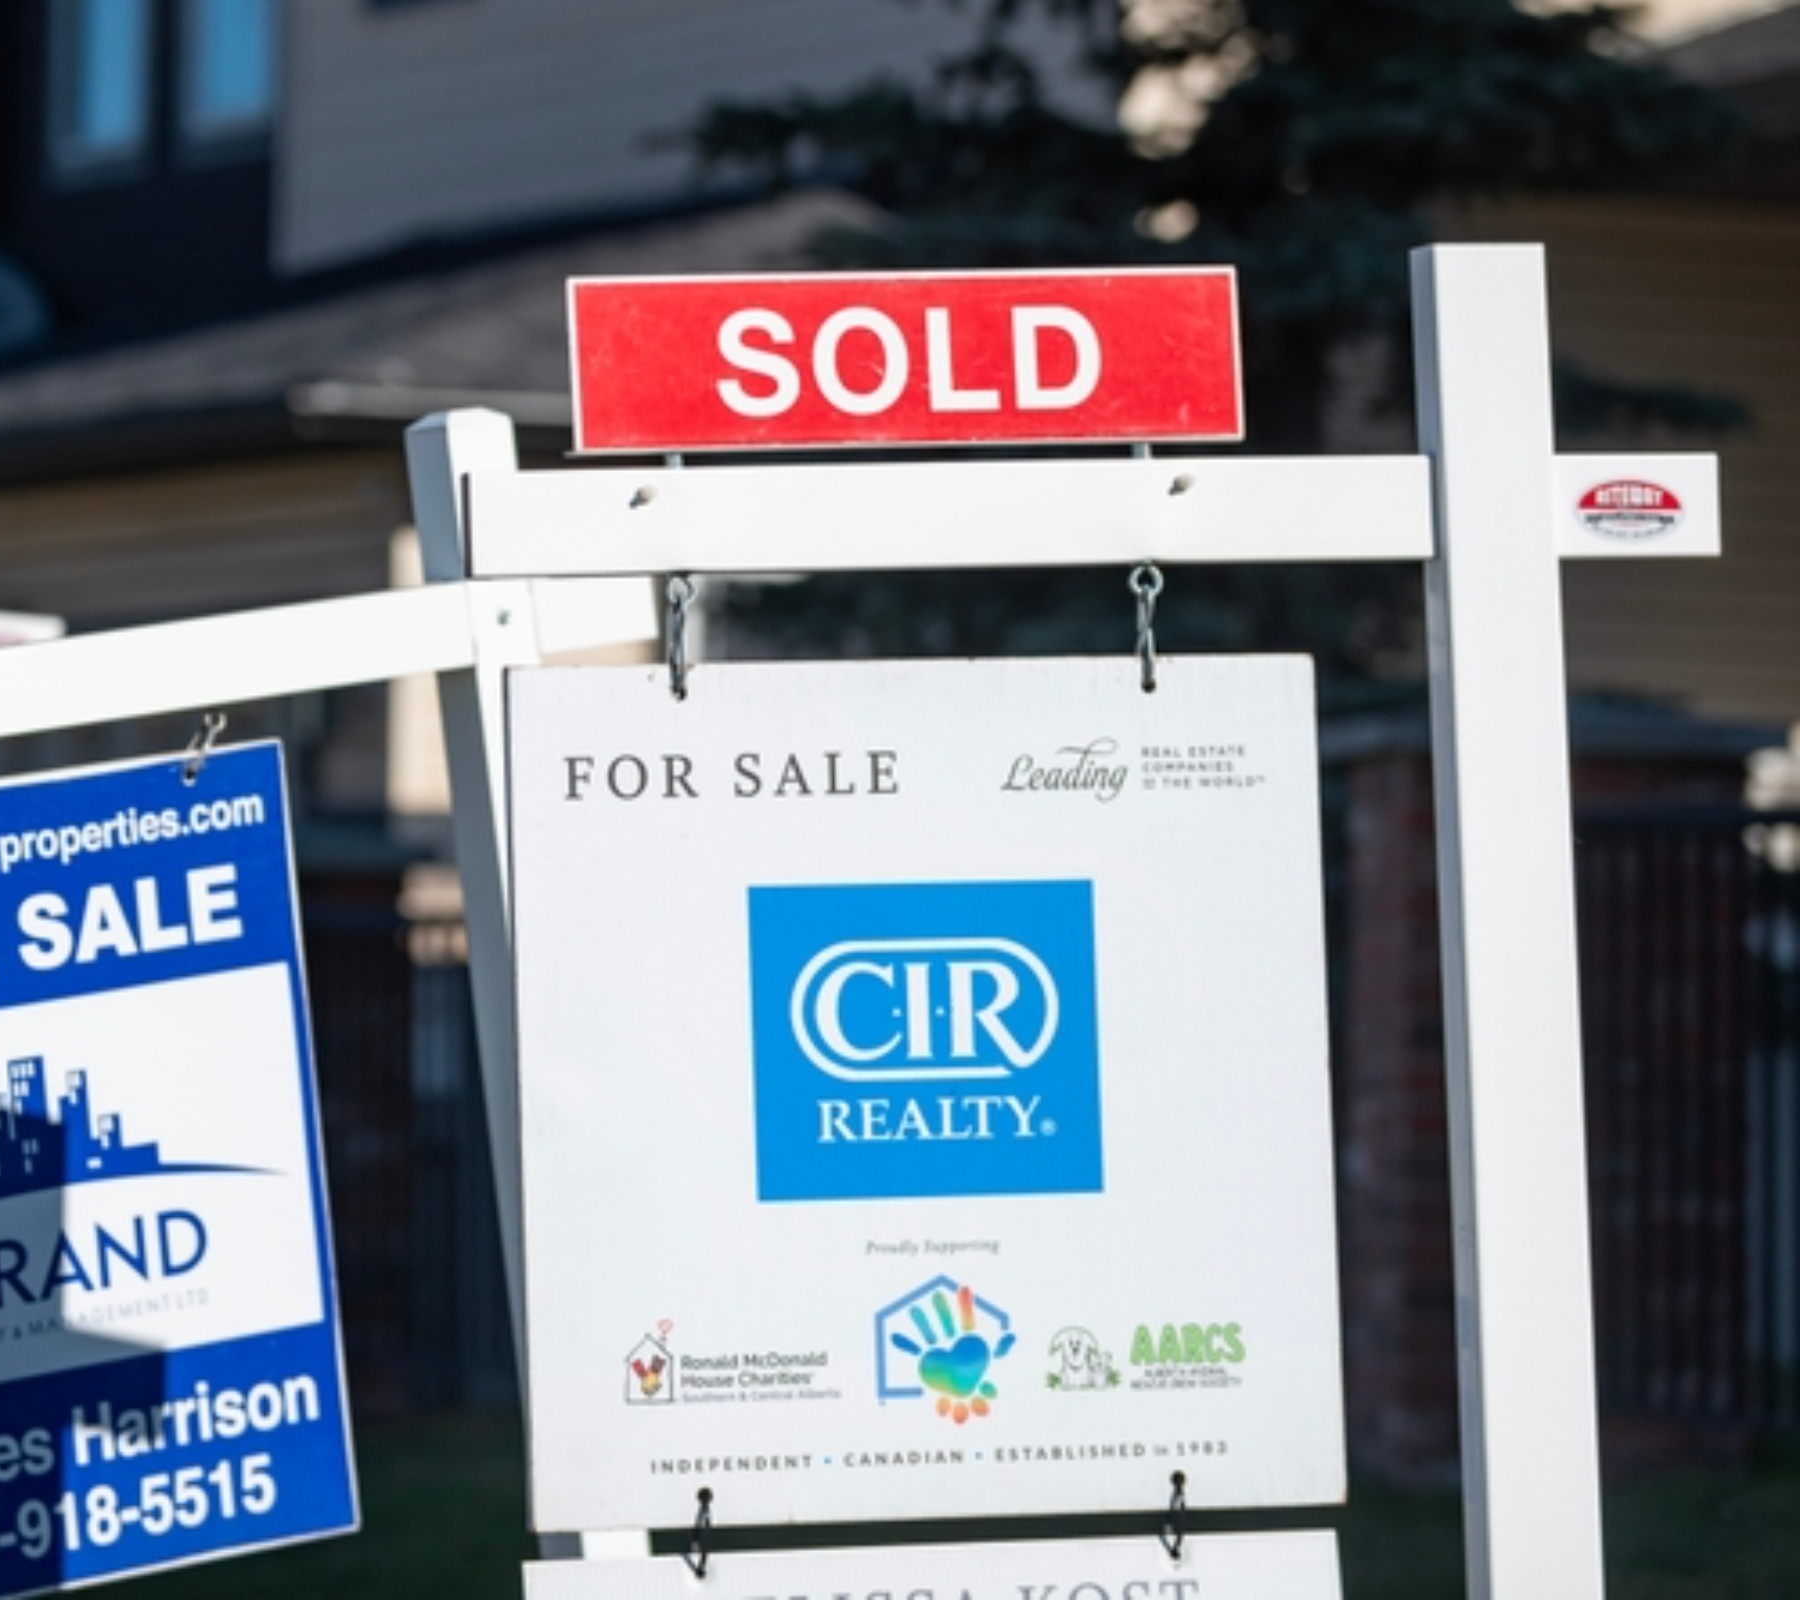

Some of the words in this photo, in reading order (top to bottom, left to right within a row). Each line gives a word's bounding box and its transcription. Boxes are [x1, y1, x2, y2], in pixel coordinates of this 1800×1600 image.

[715, 306, 1102, 417] SOLD
[1000, 736, 1128, 803] Leading
[1140, 746, 1181, 758] REAL
[1188, 744, 1245, 757] ESTATE
[1141, 760, 1234, 773] COMPANIES
[564, 754, 699, 801] FOR
[733, 751, 898, 798] SALE
[1162, 777, 1192, 789] THE
[17, 864, 243, 971] SALE
[28, 1292, 172, 1335] MANAGEMENT
[176, 1288, 210, 1309] LTD
[680, 1354, 739, 1370] Ronald
[742, 1351, 828, 1369] McDonald
[1129, 1322, 1246, 1366] AARCS
[680, 1373, 734, 1388] House
[72, 1374, 319, 1466] Harrison
[650, 1454, 814, 1475] INDEPENDENT
[842, 1448, 965, 1468] CANADIAN
[994, 1442, 1147, 1463] ESTABLISHED
[1153, 1444, 1170, 1457] in
[1175, 1440, 1229, 1457] 1983
